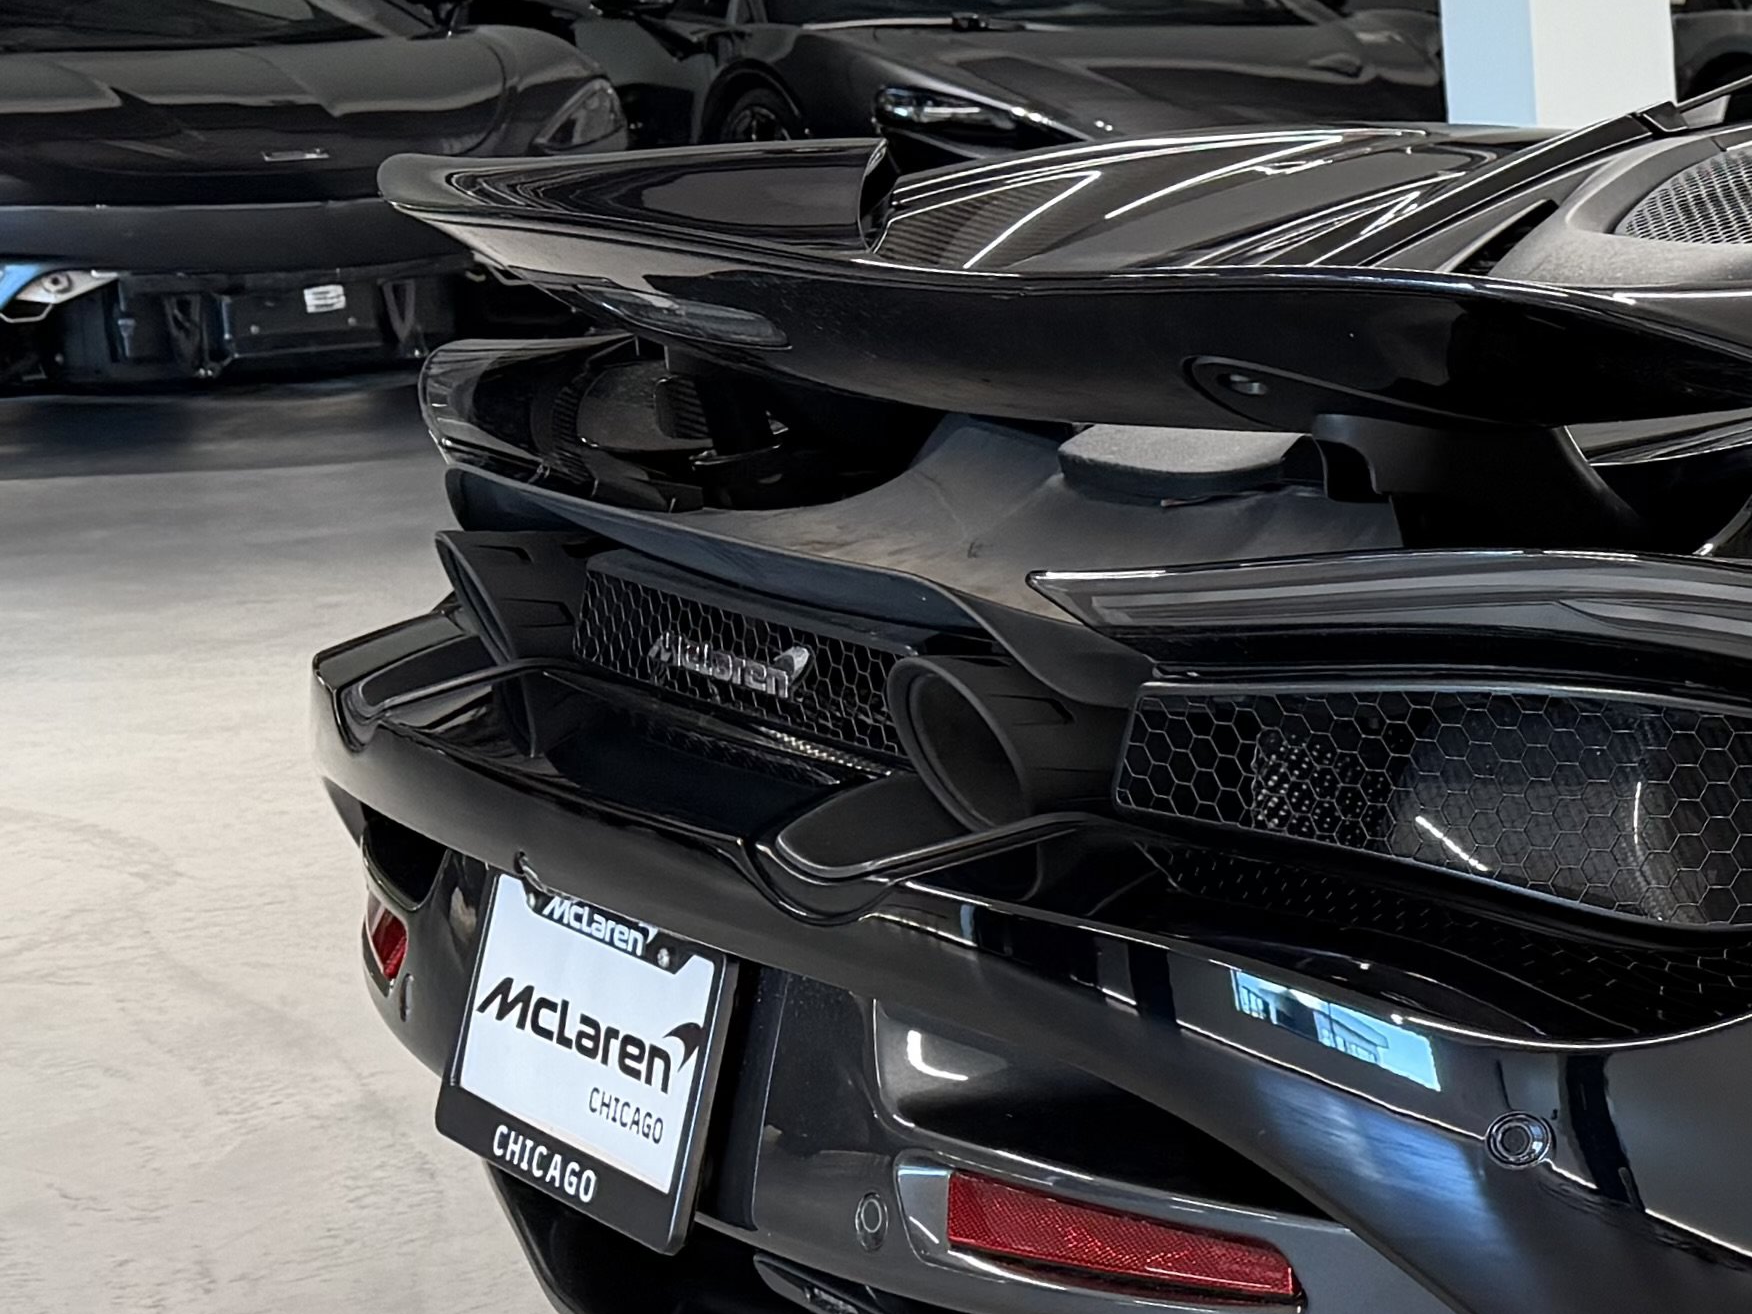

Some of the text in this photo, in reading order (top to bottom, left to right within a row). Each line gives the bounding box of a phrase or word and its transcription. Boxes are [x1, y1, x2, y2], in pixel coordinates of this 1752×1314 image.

[543, 895, 647, 957] McLaren
[477, 977, 672, 1094] McLaren
[588, 1087, 665, 1145] CHICAGO
[493, 1124, 597, 1204] CHICAGO
